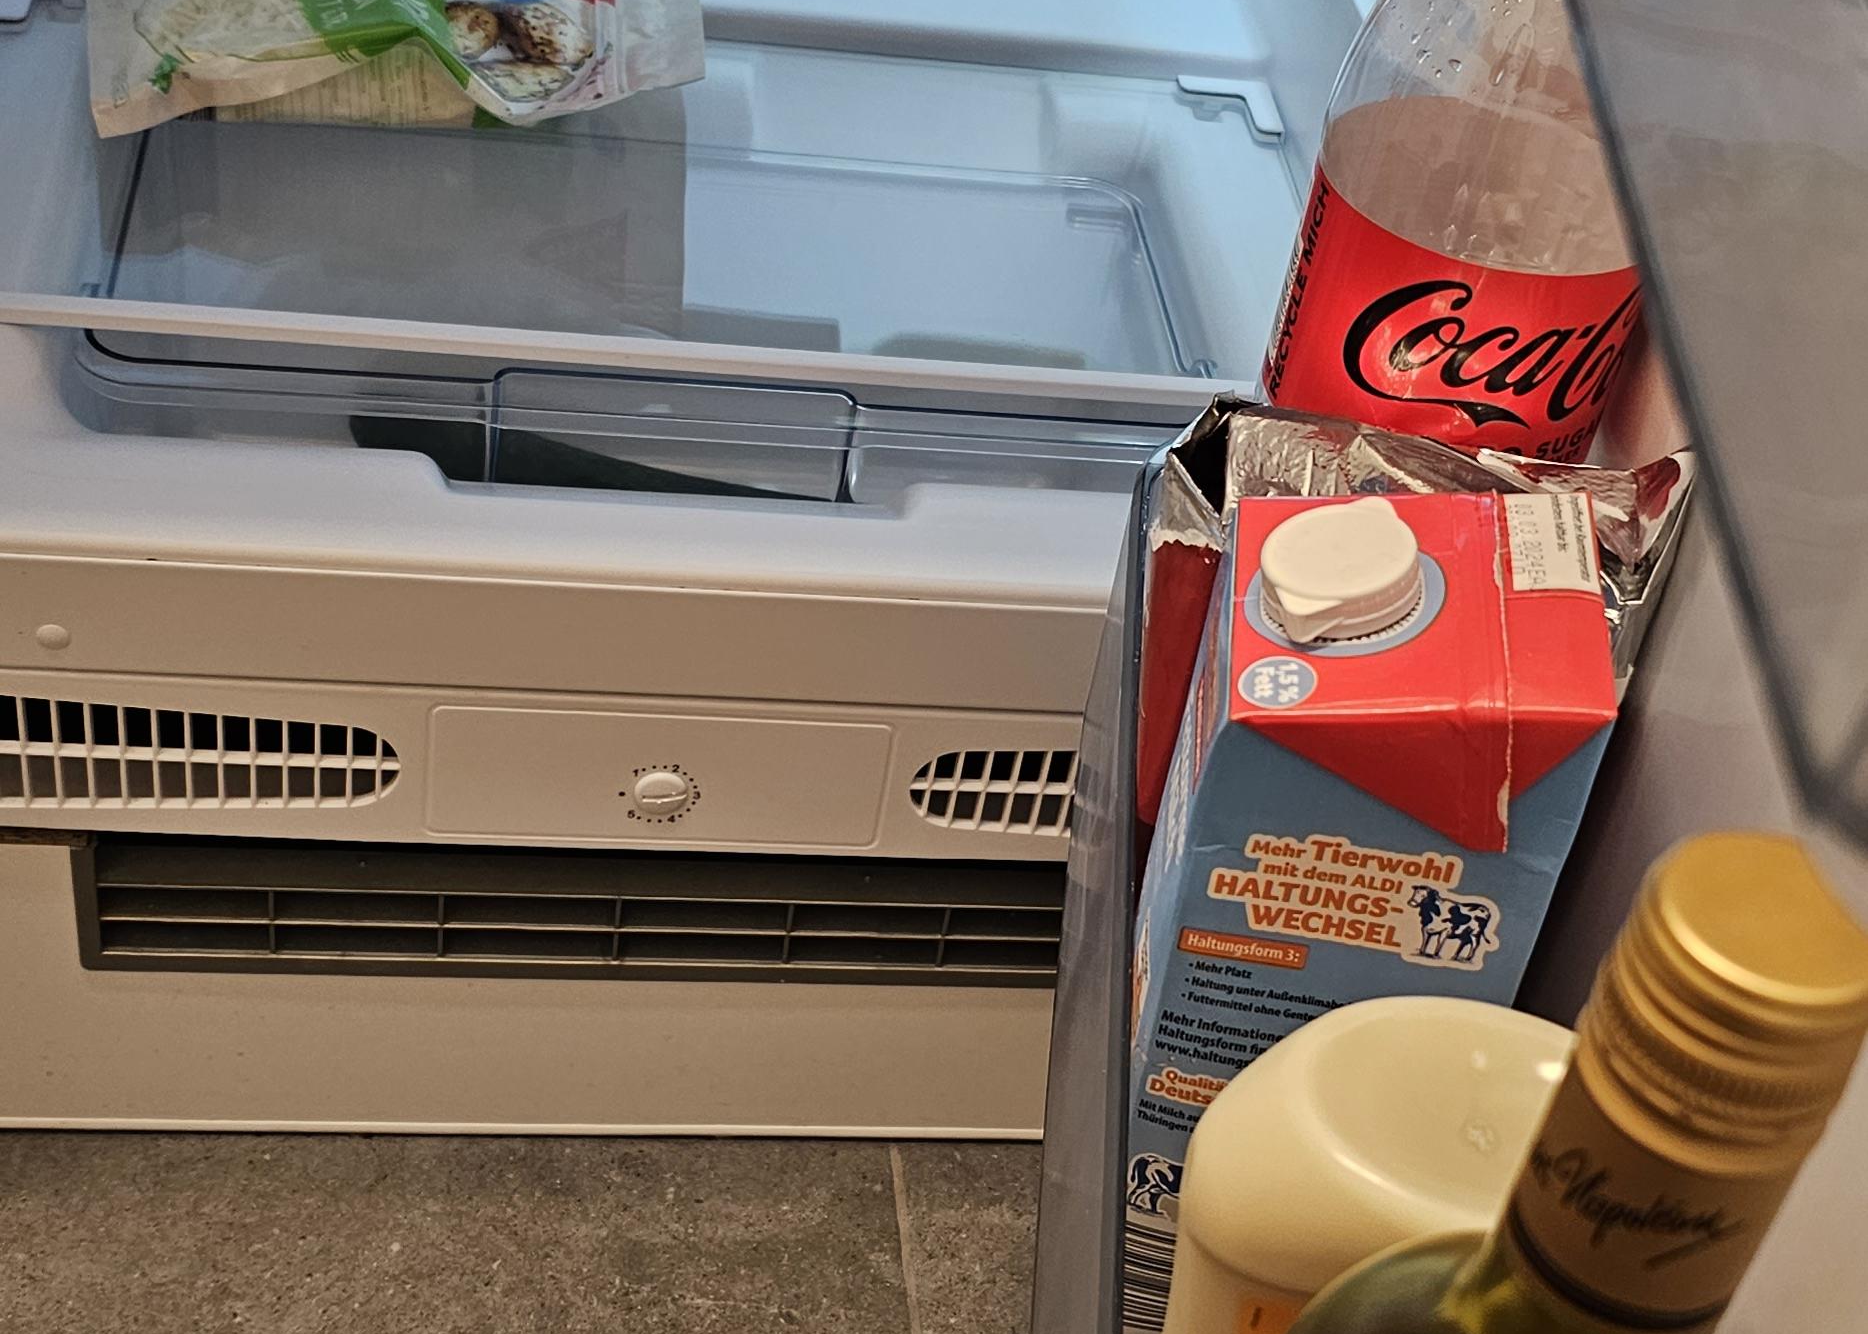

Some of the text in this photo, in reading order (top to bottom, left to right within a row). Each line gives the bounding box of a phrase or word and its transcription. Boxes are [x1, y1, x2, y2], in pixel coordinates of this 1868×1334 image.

[1269, 180, 1330, 400] RECYCLE MICH
[1536, 414, 1602, 458] SUGA
[1254, 667, 1275, 698] Fett
[672, 764, 680, 772] 2
[693, 791, 701, 800] 3
[667, 815, 676, 823] 4
[1251, 839, 1455, 883] Mehr Tierwohl
[1263, 861, 1404, 894] mit dem ALDI
[1213, 873, 1404, 916] HALTUNGS-
[1251, 904, 1402, 947] WECHSEL
[1187, 933, 1300, 963] Haltungsform 3:
[1194, 961, 1253, 979] Mehr Platz
[1191, 976, 1234, 995] Haltung
[1236, 985, 1266, 998] unter
[1187, 991, 1253, 1013] Futtermittel
[1254, 1003, 1281, 1017] ohne
[1158, 1024, 1248, 1054] Haltungsform
[1161, 1009, 1285, 1043] Mehr Informatione
[1155, 1038, 1254, 1069] www.haltungs
[1149, 1078, 1215, 1105] Deuts
[1165, 1070, 1228, 1092] Qualitä
[1137, 1108, 1188, 1131] Thüringen
[1138, 1099, 1200, 1123] Mit Milch au
